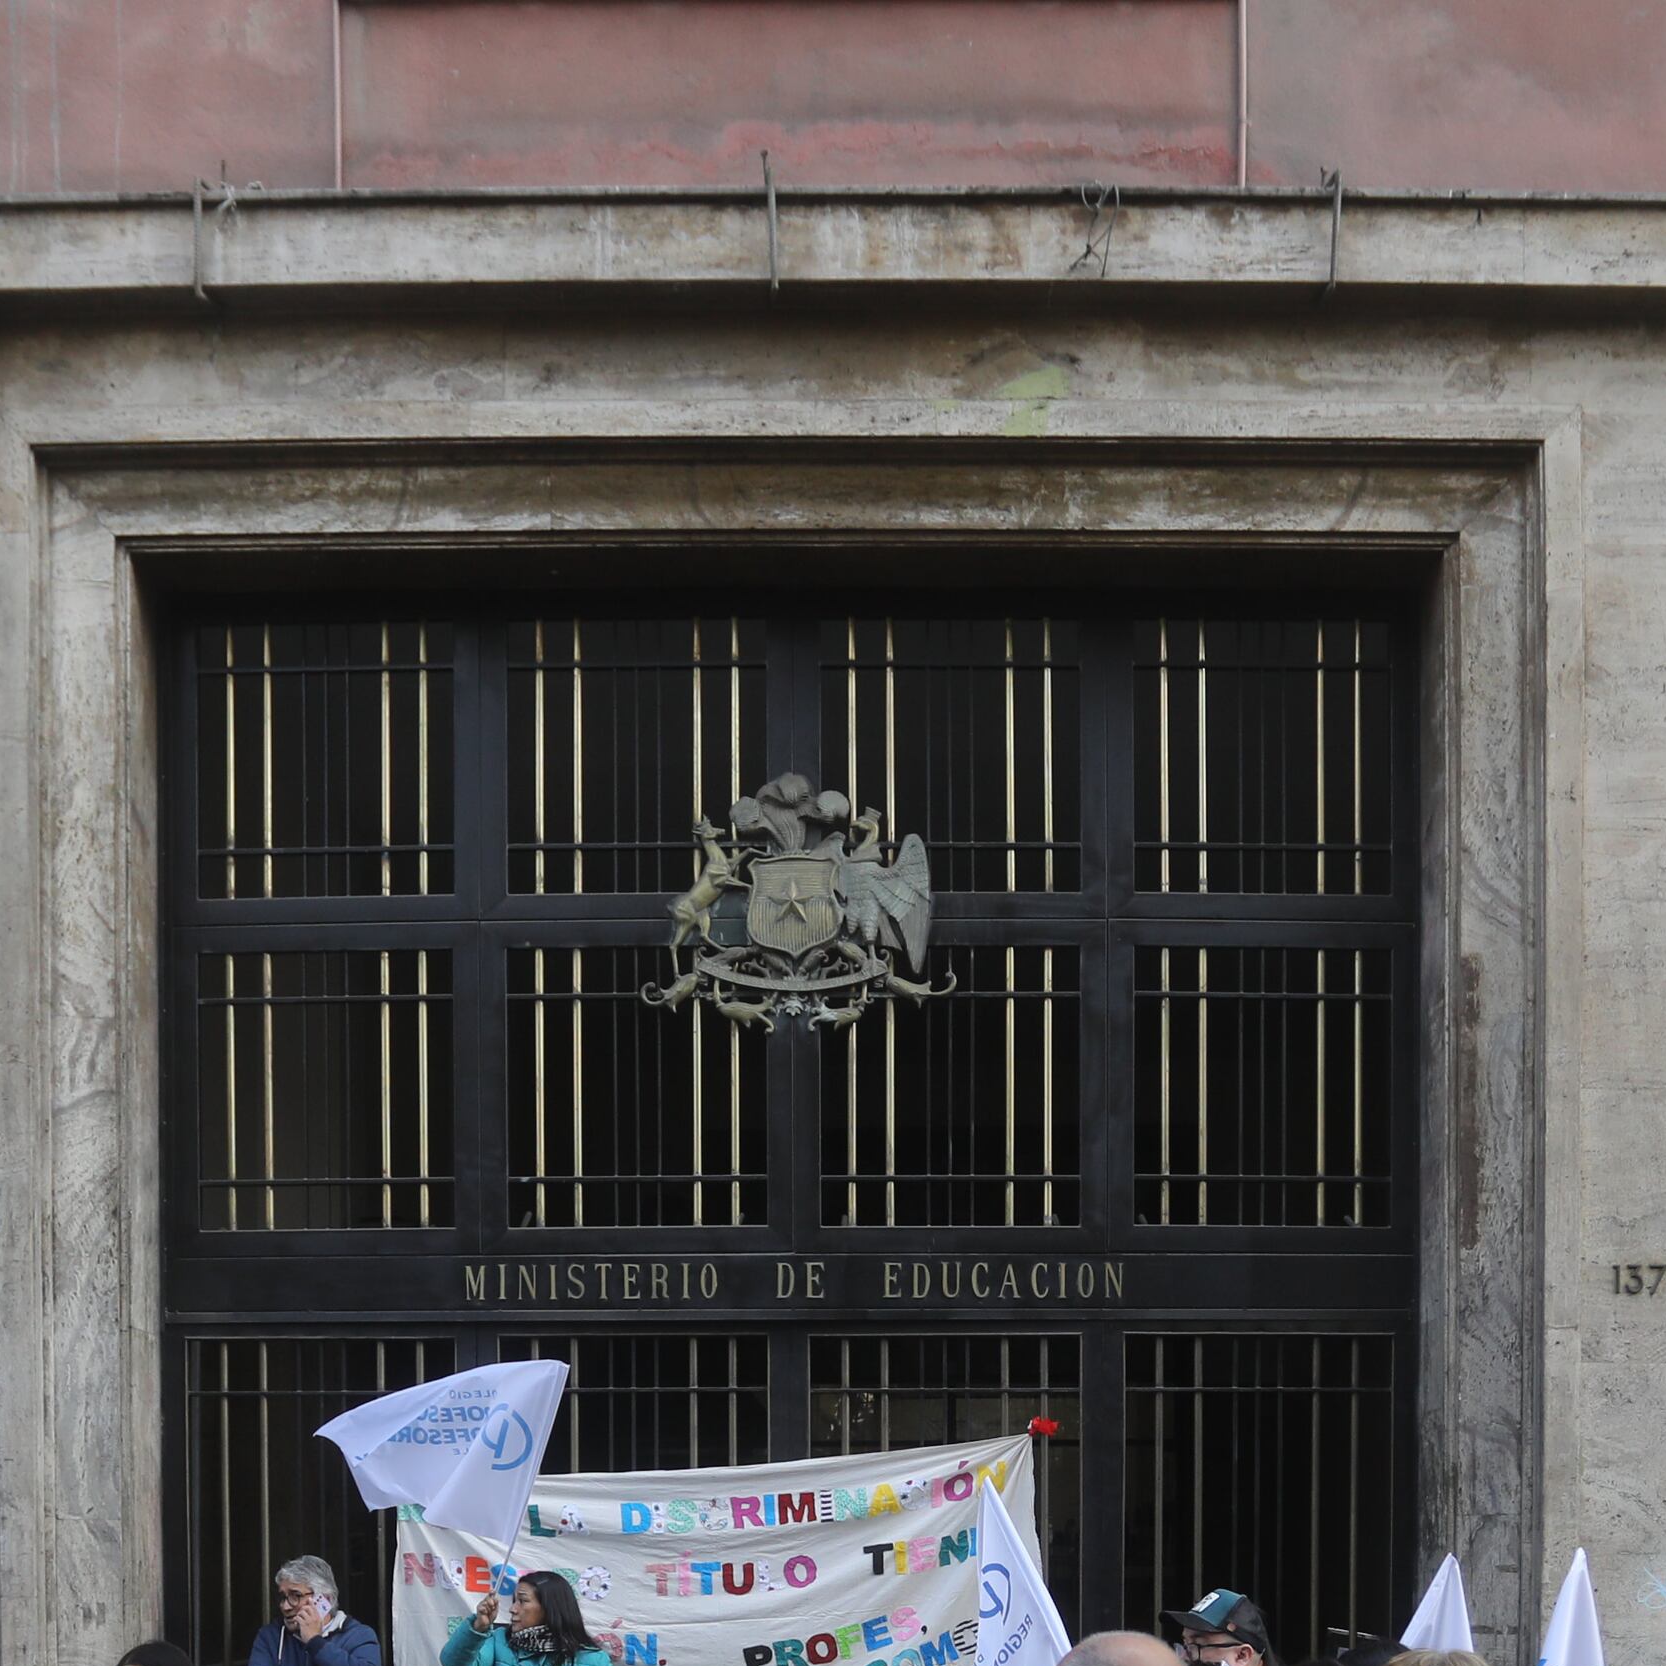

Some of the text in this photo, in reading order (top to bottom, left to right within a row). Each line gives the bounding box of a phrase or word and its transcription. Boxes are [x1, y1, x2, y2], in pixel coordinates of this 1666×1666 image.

[464, 1261, 1125, 1301] MINISTERIO DE EDUCACION
[620, 1460, 1006, 1535] DISCRIMINACIÓN
[645, 1549, 818, 1597] TÍTULO
